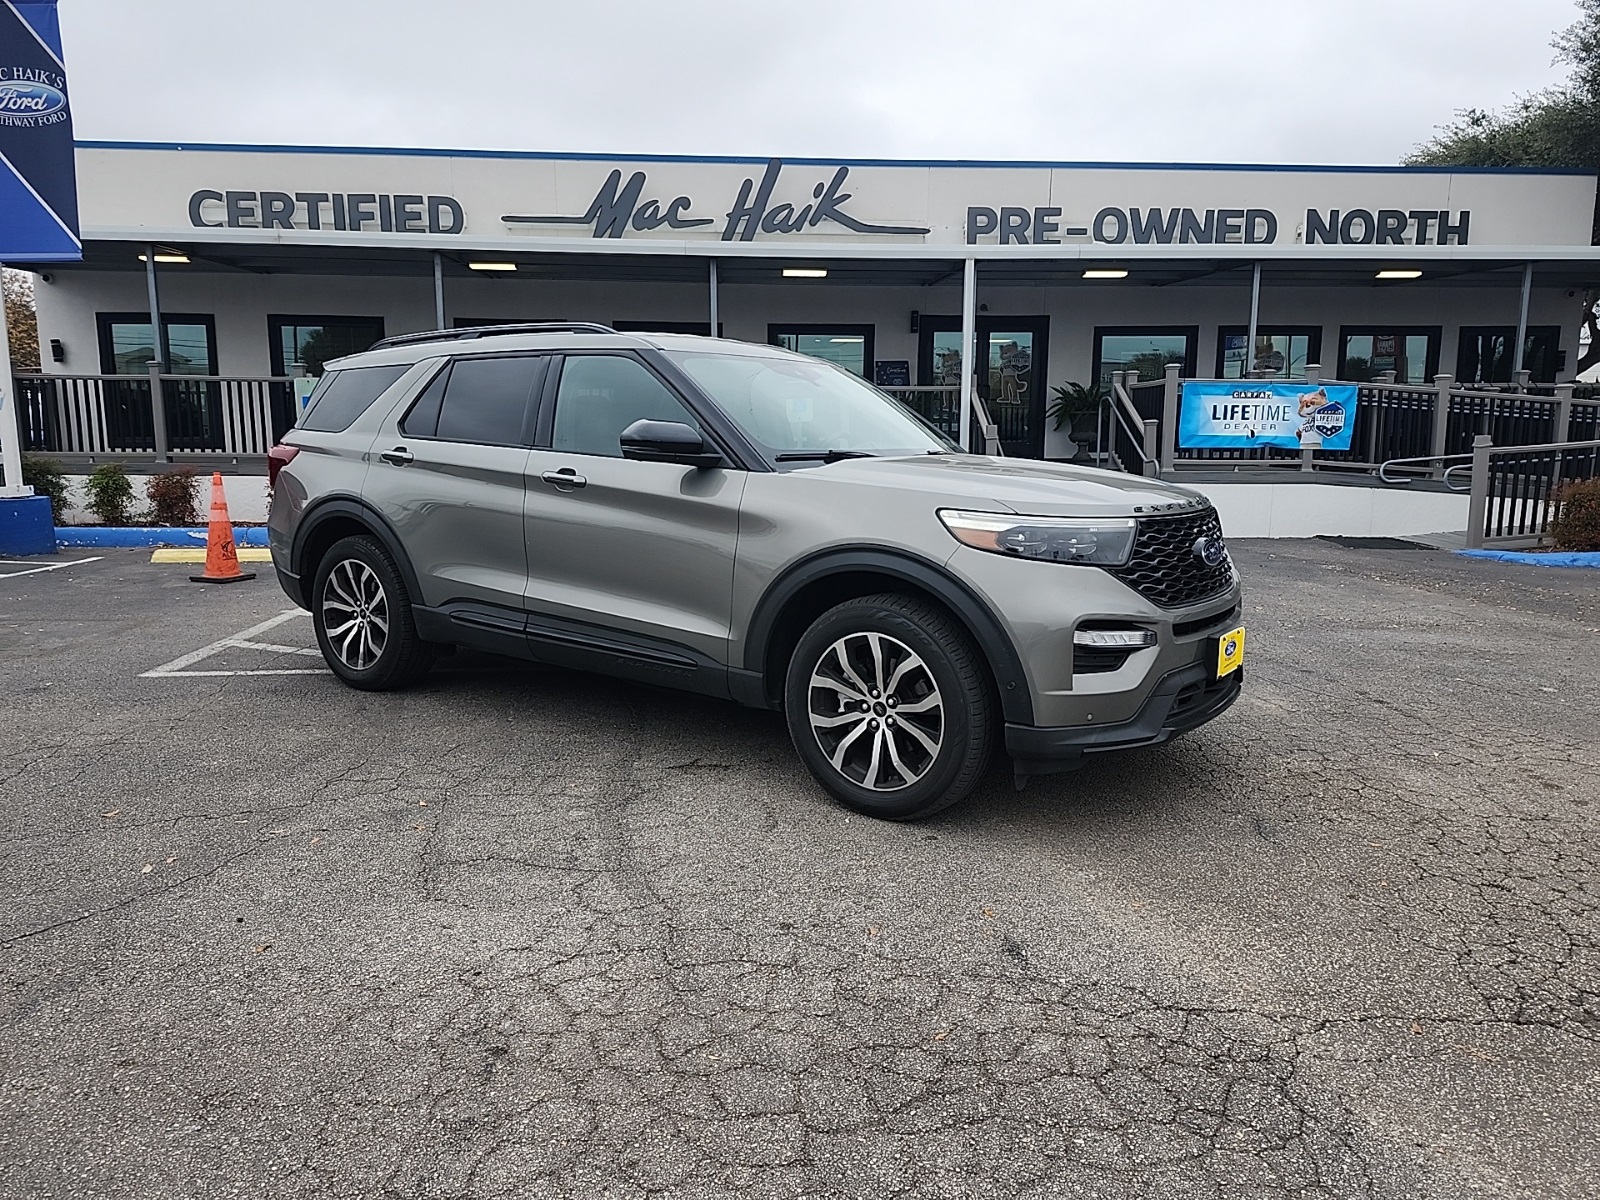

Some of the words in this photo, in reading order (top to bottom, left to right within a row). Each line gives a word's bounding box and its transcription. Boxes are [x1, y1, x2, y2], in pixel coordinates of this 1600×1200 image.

[13, 67, 64, 88] HAIK'S
[0, 86, 48, 111] Ford
[38, 111, 67, 127] FORD
[501, 169, 714, 239] Mac
[721, 158, 932, 242] Haik
[188, 189, 465, 235] CERTIFIED
[967, 207, 1278, 245] PRE-OWNED
[1306, 208, 1470, 246] NORTH
[1232, 391, 1273, 399] CARFAX
[1212, 405, 1291, 422] LIFETIME
